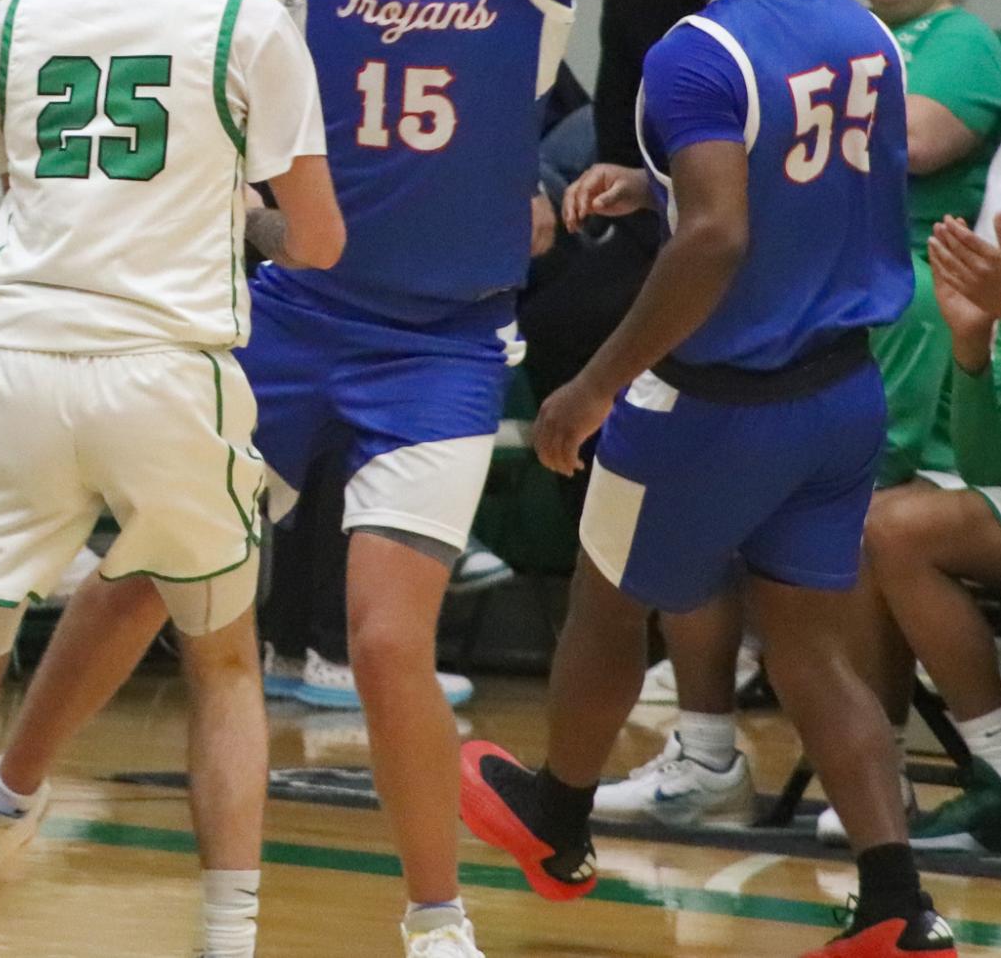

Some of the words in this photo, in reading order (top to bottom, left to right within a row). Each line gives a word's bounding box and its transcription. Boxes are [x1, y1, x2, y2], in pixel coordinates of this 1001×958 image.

[35, 55, 172, 181] 25
[355, 59, 458, 154] 15
[783, 51, 889, 185] 55
